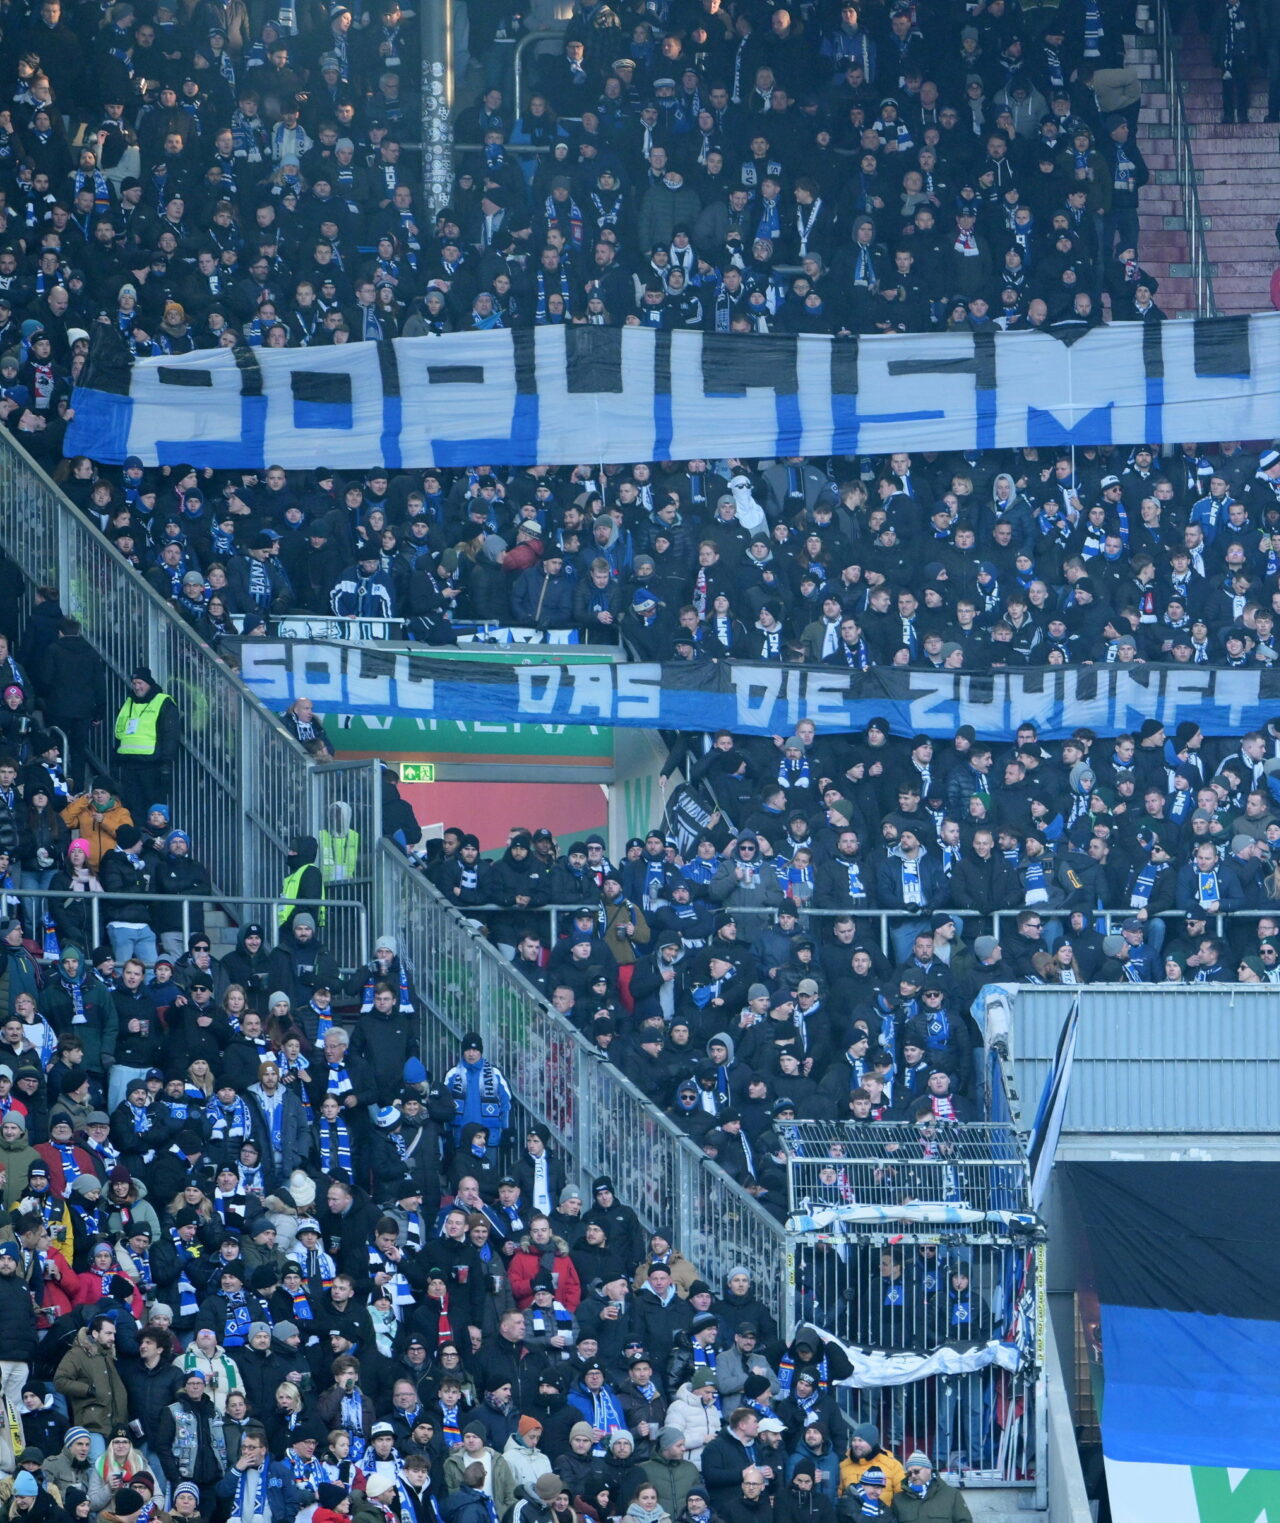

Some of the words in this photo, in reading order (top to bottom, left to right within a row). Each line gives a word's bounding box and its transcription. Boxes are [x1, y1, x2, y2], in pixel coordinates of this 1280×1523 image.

[241, 643, 434, 711] SOLL
[514, 662, 662, 719] DAS
[730, 665, 852, 728] DIE
[909, 668, 1262, 731] ZUKUNFT
